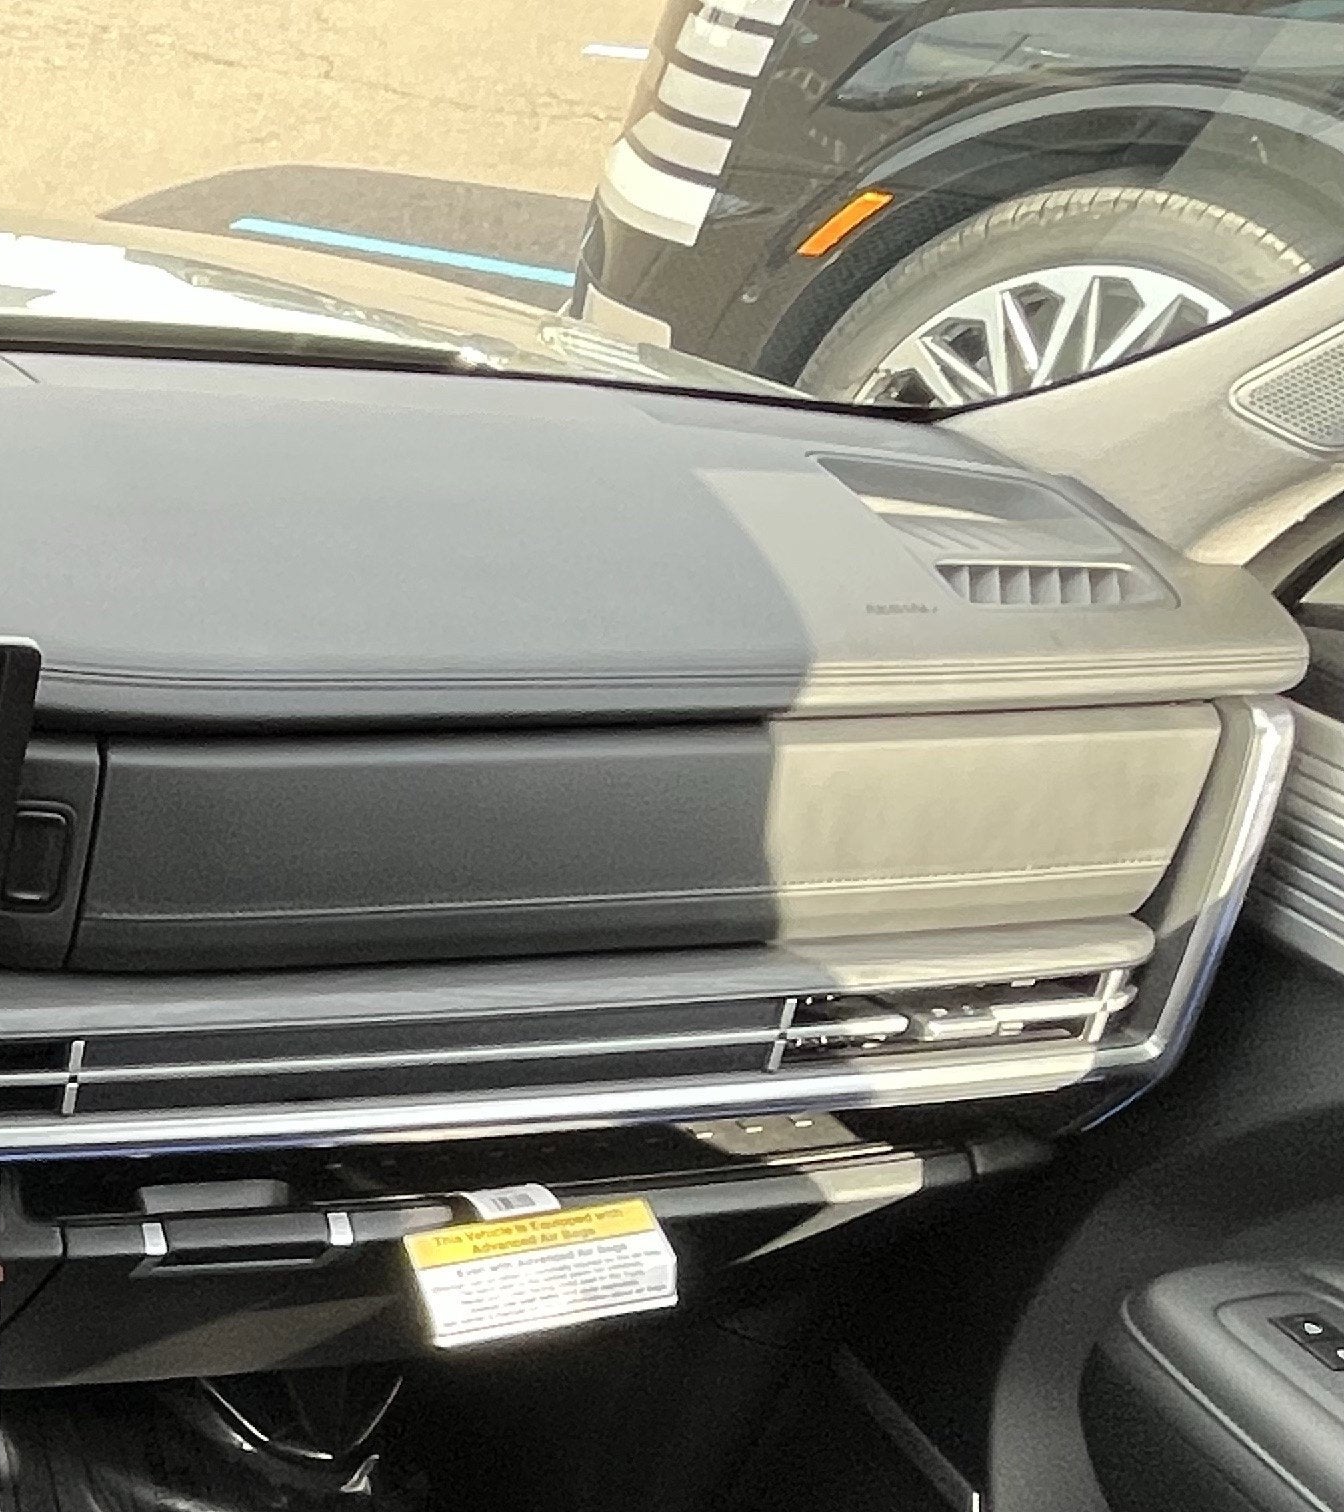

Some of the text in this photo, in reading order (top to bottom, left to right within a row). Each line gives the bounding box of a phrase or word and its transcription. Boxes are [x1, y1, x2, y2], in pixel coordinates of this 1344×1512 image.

[434, 1235, 463, 1248] This
[464, 1227, 512, 1243] Vehicle
[530, 1212, 593, 1232] Equipped
[595, 1207, 624, 1220] with
[472, 1235, 537, 1255] Advanced
